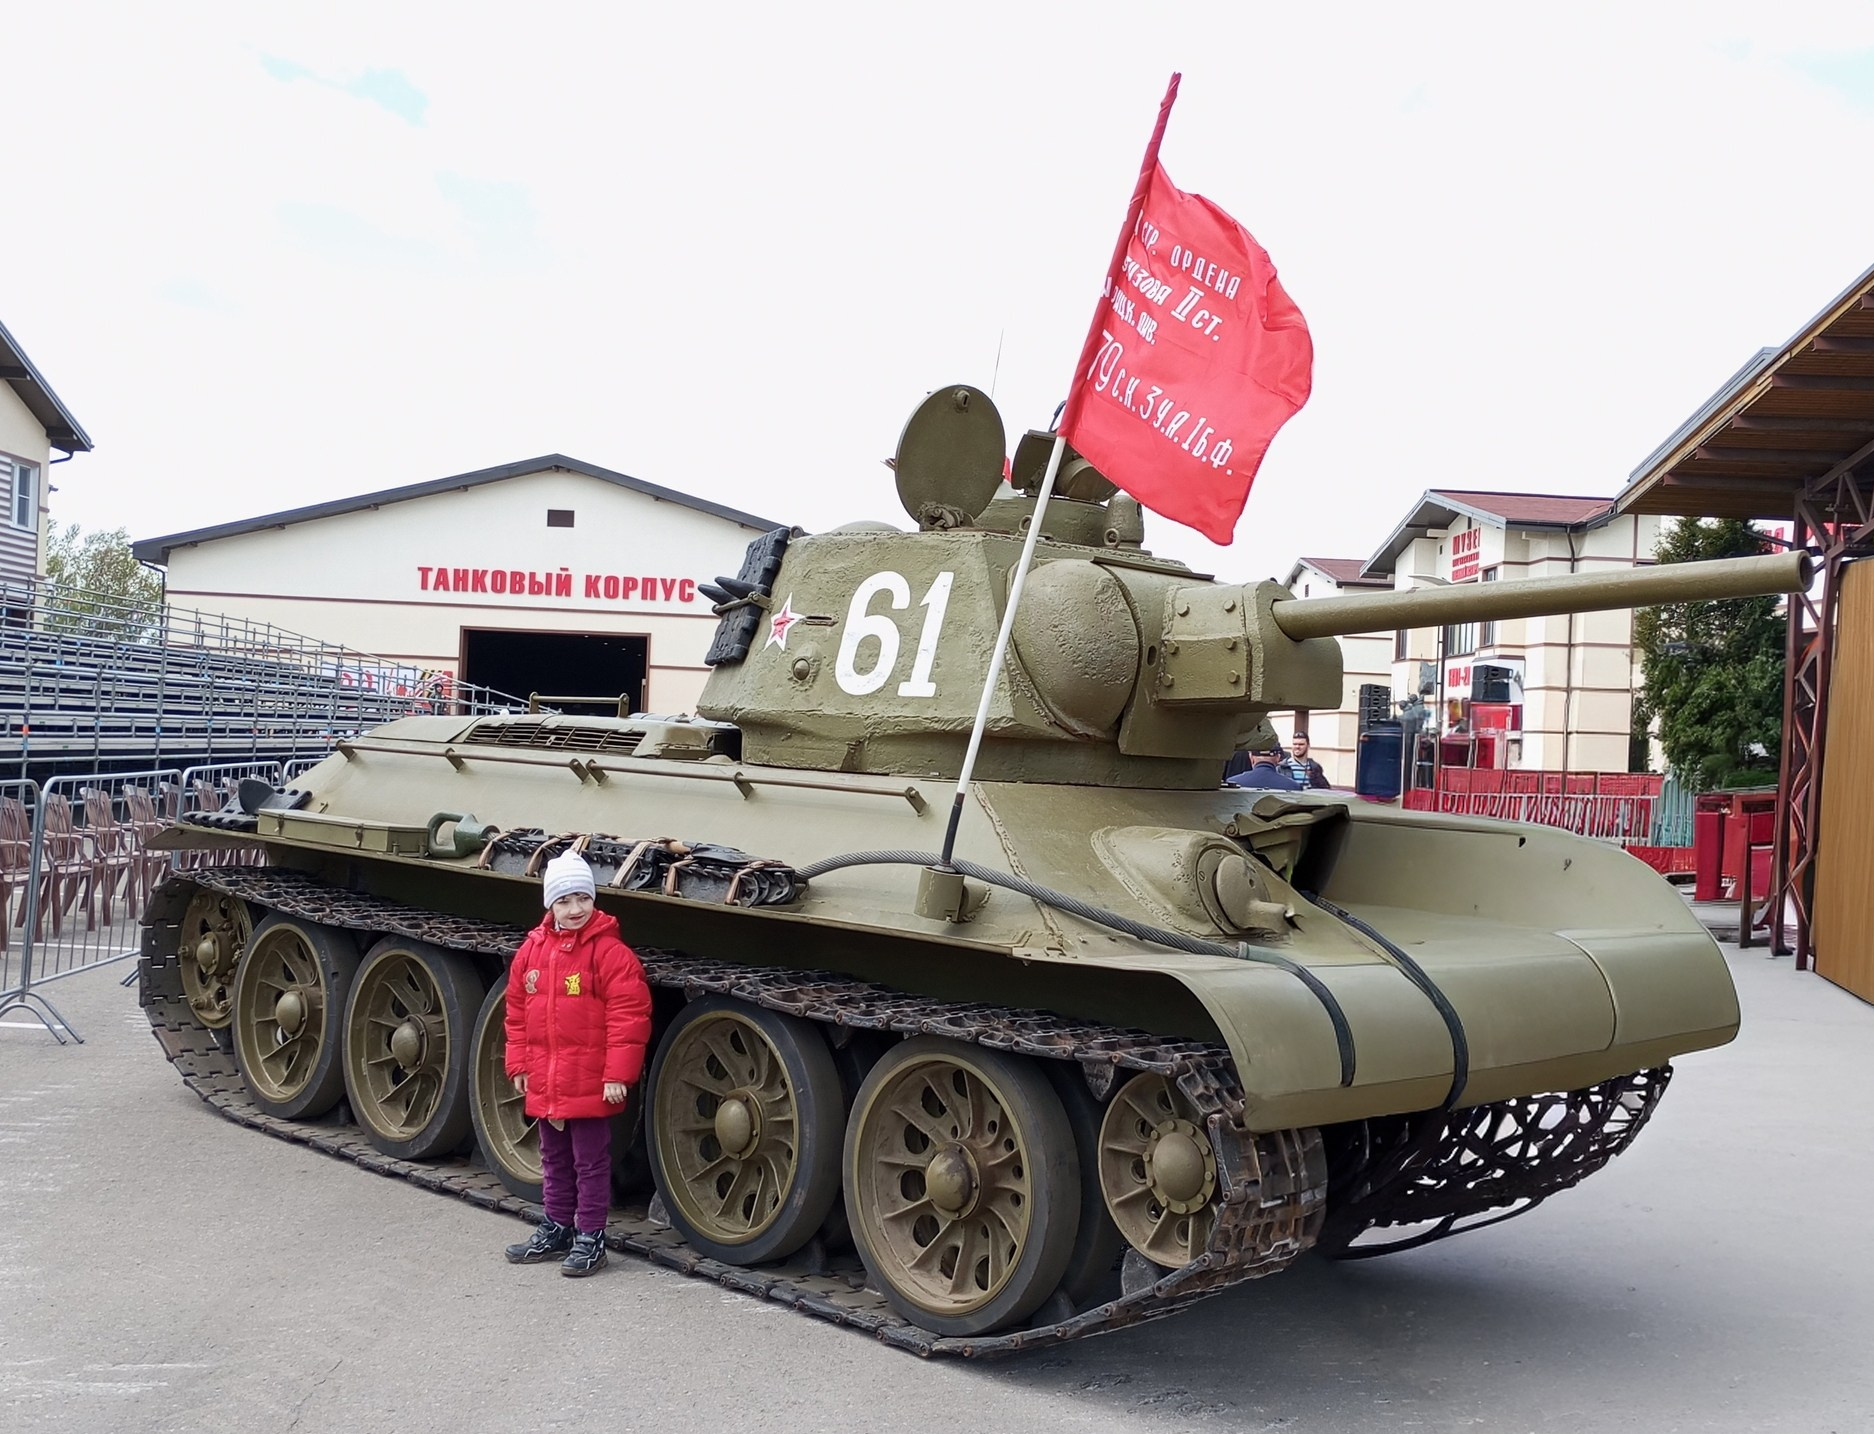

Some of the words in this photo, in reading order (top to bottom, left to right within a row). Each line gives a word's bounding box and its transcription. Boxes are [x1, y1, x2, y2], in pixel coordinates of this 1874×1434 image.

[1170, 245, 1242, 300] ОРДЕНА
[417, 566, 572, 597] ТАНКОВЫЙ
[584, 574, 695, 603] КОРПУС
[834, 570, 955, 698] 61
